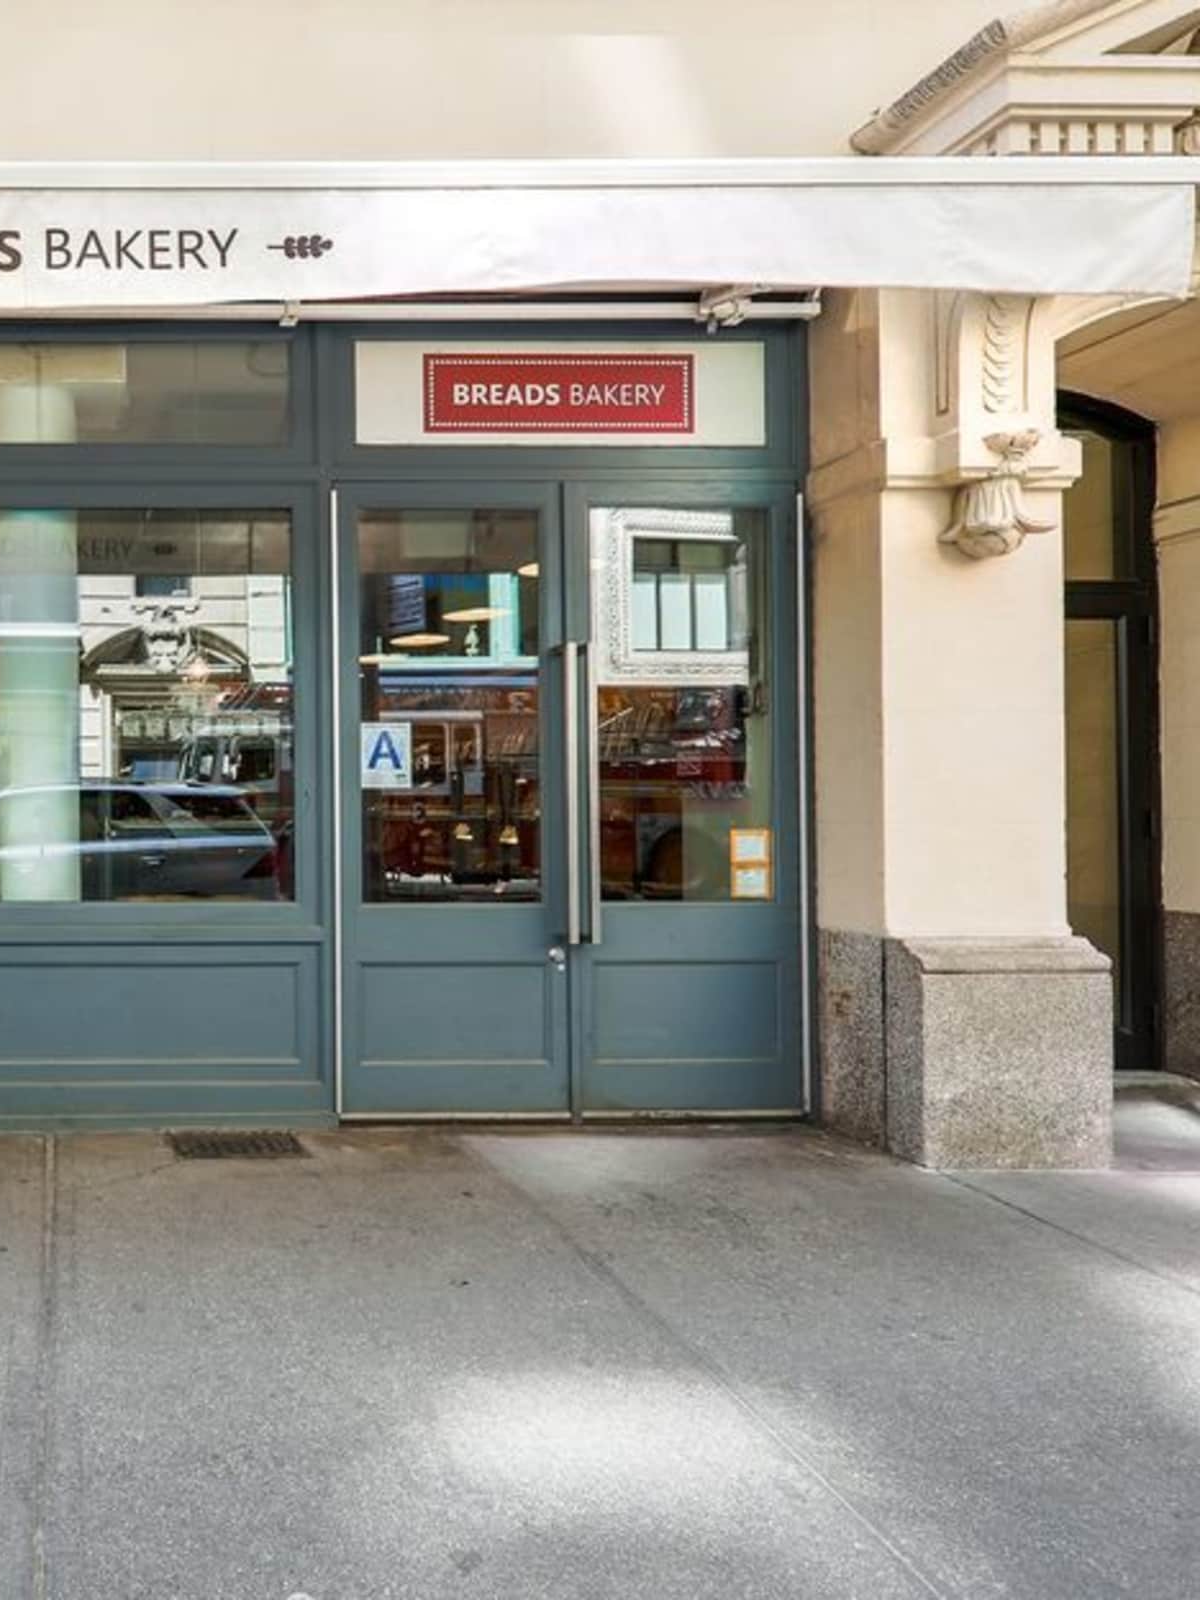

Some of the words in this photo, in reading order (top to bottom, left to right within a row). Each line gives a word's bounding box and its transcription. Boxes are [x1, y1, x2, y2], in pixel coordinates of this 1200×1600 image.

[45, 228, 238, 270] BAKERY
[452, 383, 561, 406] BREADS
[569, 383, 666, 407] BAKERY
[367, 730, 402, 770] A
